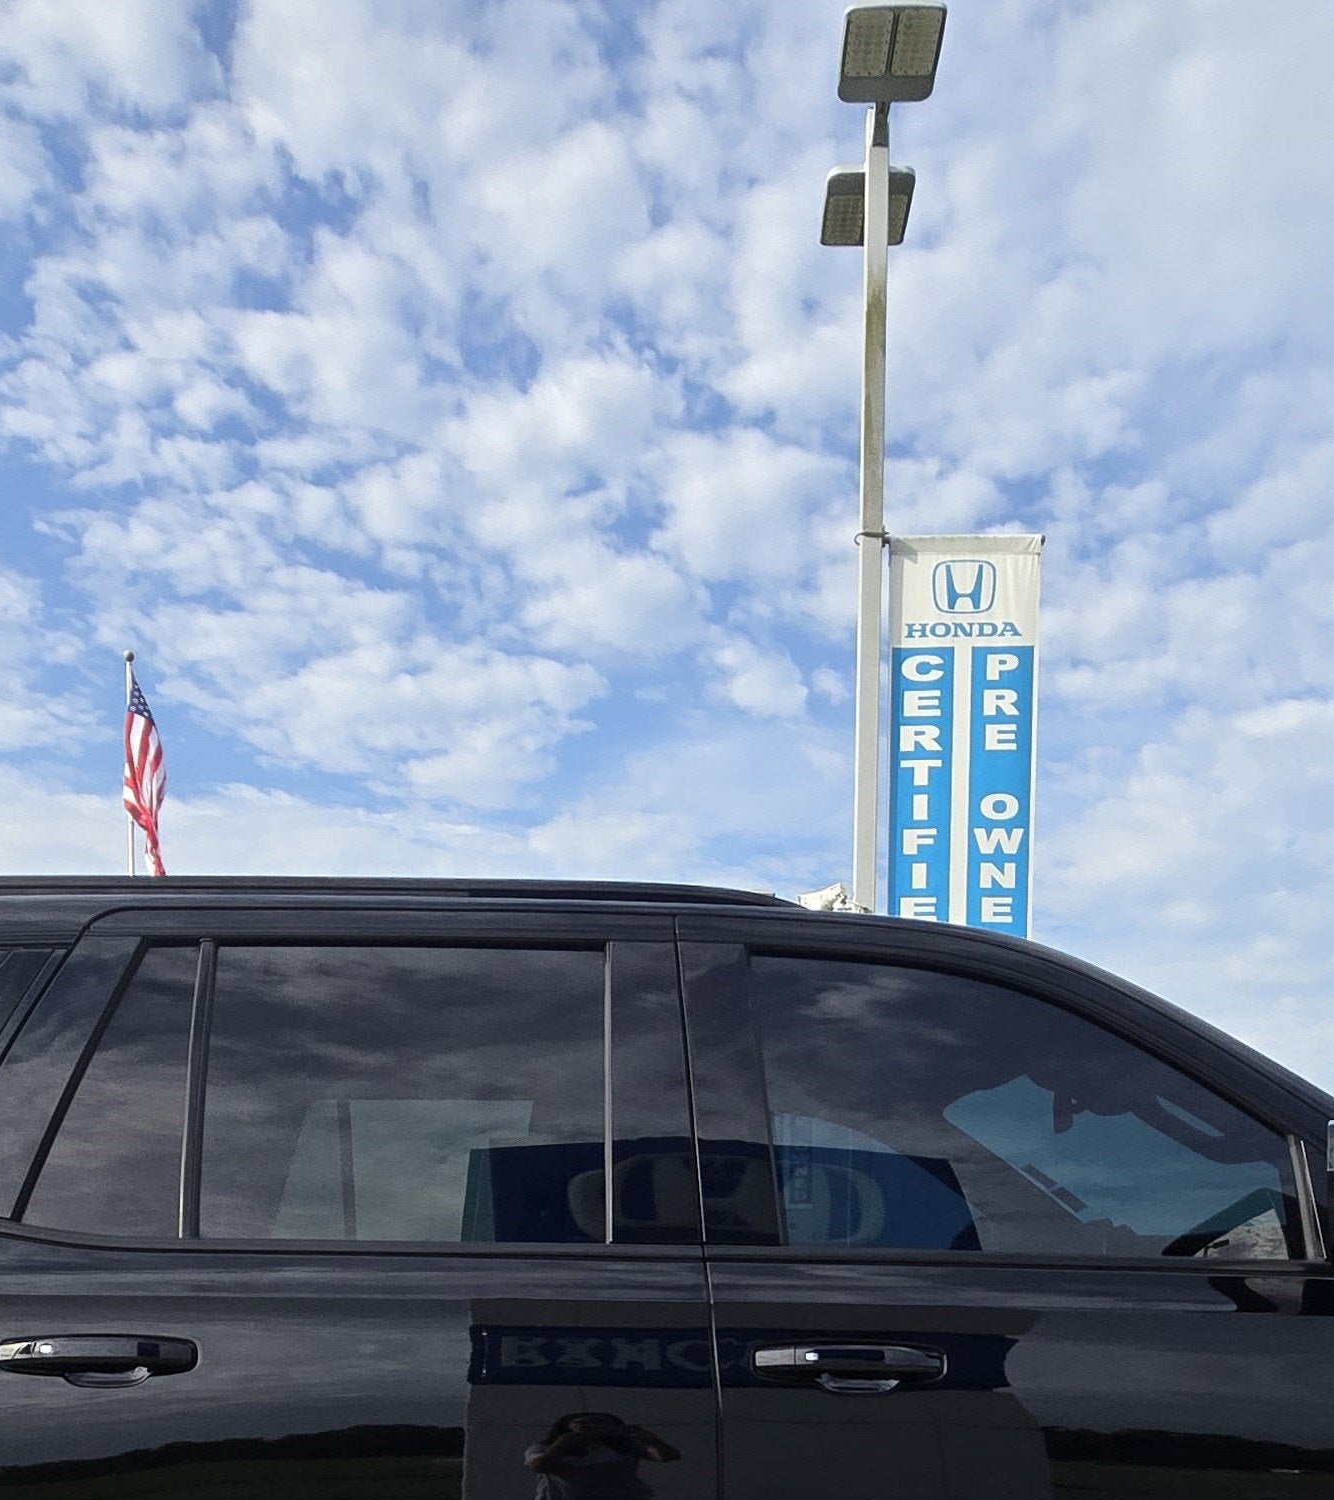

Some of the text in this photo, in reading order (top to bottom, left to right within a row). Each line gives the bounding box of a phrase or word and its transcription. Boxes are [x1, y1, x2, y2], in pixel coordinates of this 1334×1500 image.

[904, 621, 1022, 639] HONDA
[899, 654, 945, 921] CERTIFIE
[973, 653, 1024, 924] PRE OWNE
